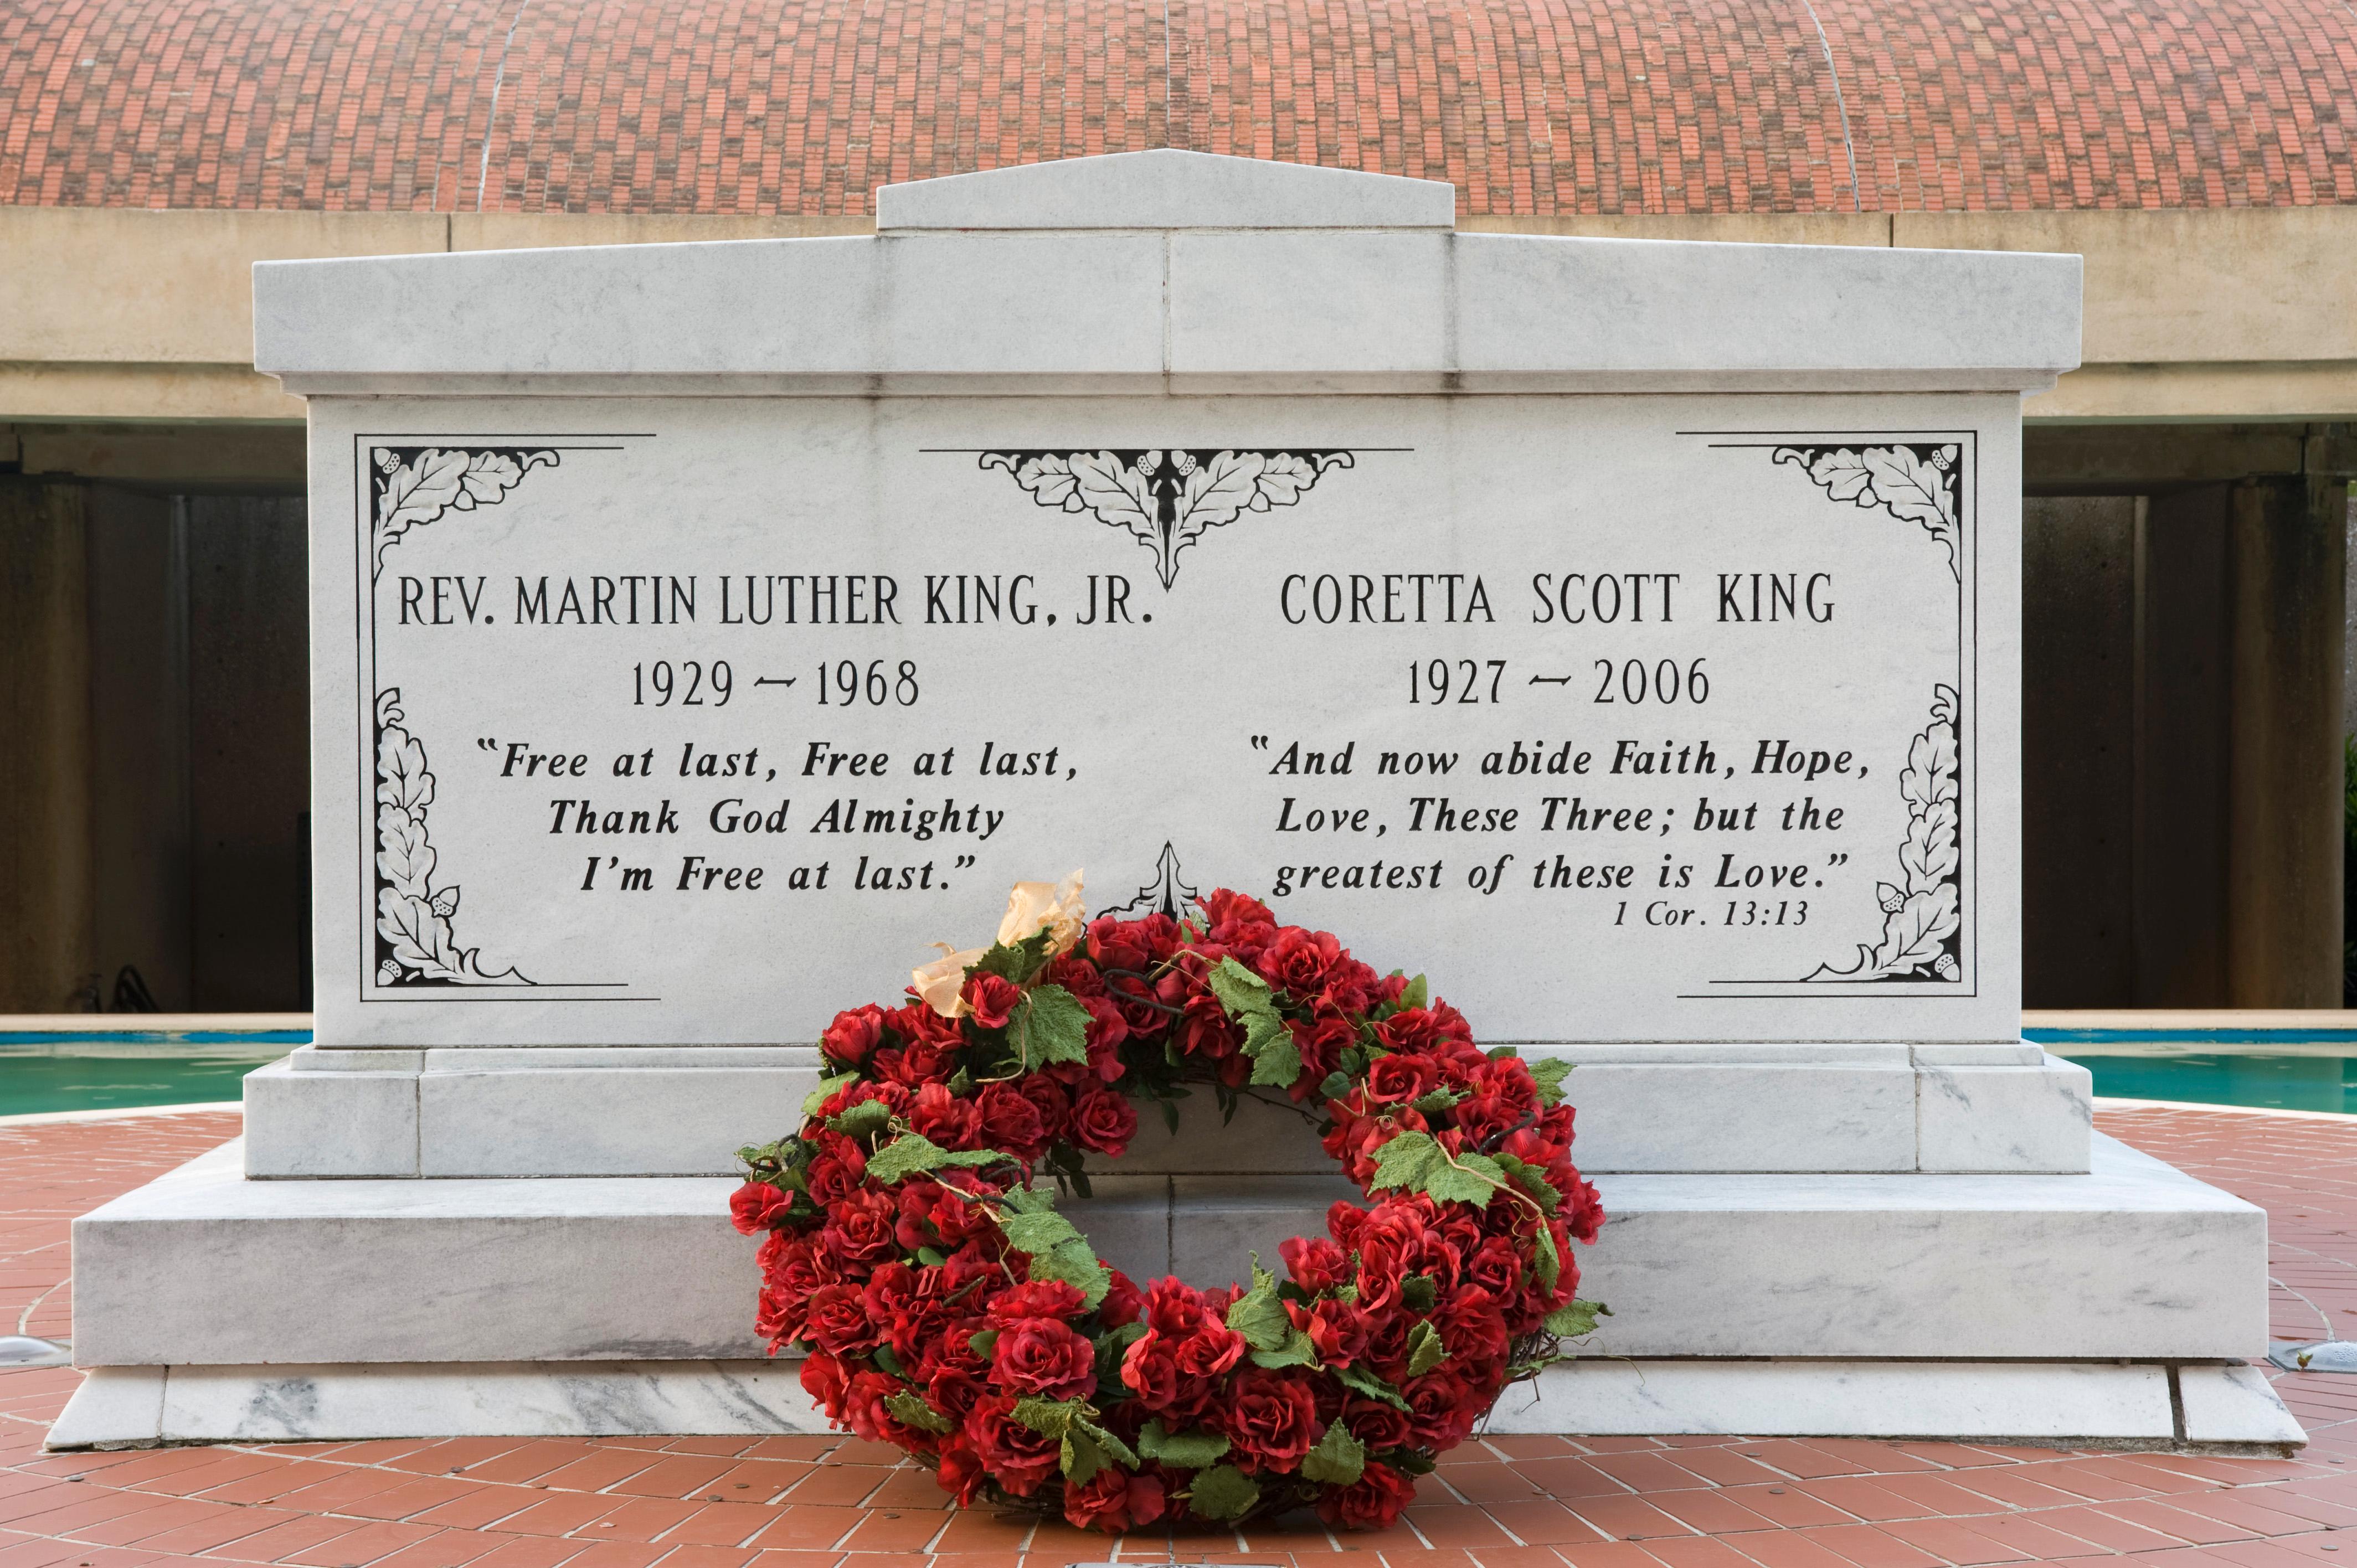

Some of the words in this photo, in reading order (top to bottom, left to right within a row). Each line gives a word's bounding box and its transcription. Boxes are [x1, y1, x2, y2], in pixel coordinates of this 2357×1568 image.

[399, 576, 493, 625] REV.
[514, 576, 697, 625] MARTIN
[719, 576, 902, 625] LUTHER
[924, 575, 1056, 626] KING,
[1076, 575, 1154, 625] JR.
[1282, 574, 1495, 624] CORETTA
[1533, 574, 1679, 623] SCOTT
[1717, 573, 1835, 623] KING
[634, 661, 732, 706] 1929
[819, 660, 918, 706] 1968
[1410, 659, 1507, 705] 1927
[1594, 658, 1710, 704] 2006
[613, 749, 653, 776] at
[680, 743, 778, 781] last,
[802, 742, 888, 776] Free
[914, 747, 954, 776] at
[980, 742, 1078, 781] last,
[1378, 752, 1458, 775] now
[1481, 740, 1591, 775] abide
[1610, 740, 1735, 779] Faith,
[1752, 740, 1869, 779] Hope,
[550, 800, 678, 834] Thank
[710, 799, 790, 833] God
[810, 798, 1003, 839] Almighty
[1276, 798, 1386, 837] Love,
[1409, 798, 1518, 832] These
[1541, 797, 1674, 836] Three;
[1694, 797, 1757, 831] but
[1782, 797, 1843, 831] the
[676, 857, 763, 890] Free
[789, 862, 829, 890] at
[1273, 860, 1442, 896] greatest
[1468, 854, 1514, 895] of
[1534, 855, 1633, 888] these
[1659, 854, 1693, 888] is
[1614, 902, 1627, 925] 1
[1646, 901, 1705, 925] Cor.
[1724, 901, 1807, 925] 13:13
